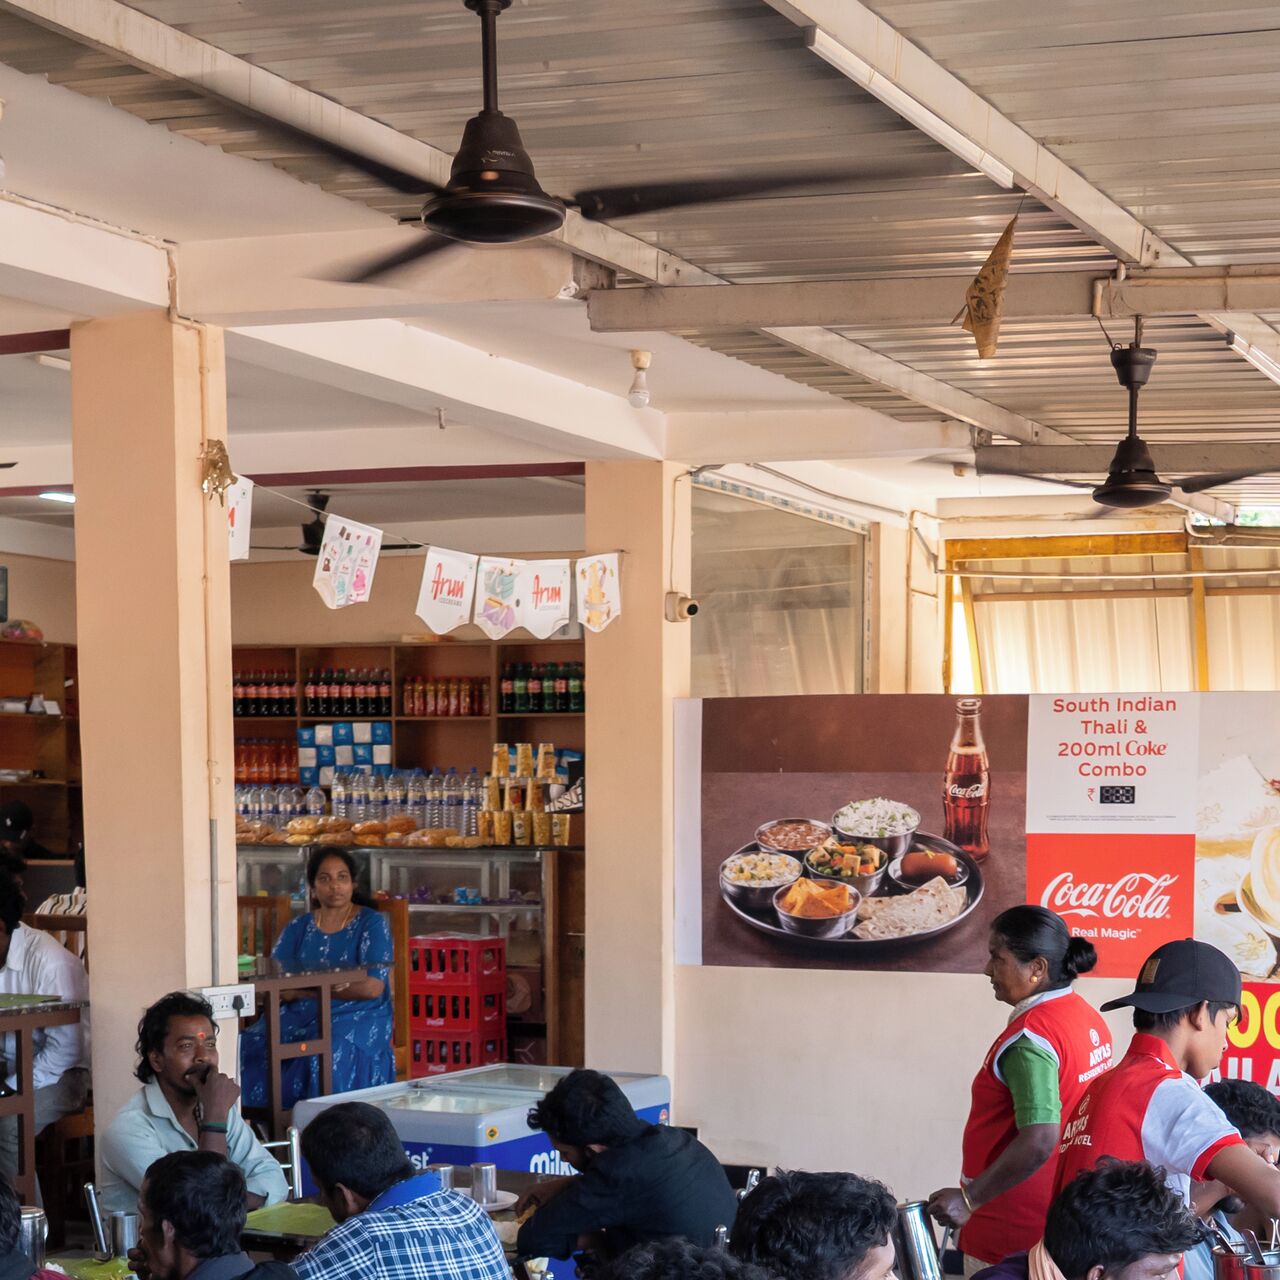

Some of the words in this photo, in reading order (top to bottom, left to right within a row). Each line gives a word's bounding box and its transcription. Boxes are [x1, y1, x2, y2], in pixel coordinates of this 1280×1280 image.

[431, 562, 465, 600] Arun
[532, 574, 561, 610] Arun
[1053, 697, 1110, 713] South
[1117, 696, 1177, 712] Indian
[1081, 719, 1128, 734] Thali
[1134, 719, 1148, 734] &
[1058, 742, 1121, 756] 200ml
[1125, 740, 1166, 756] Coke
[1078, 762, 1148, 777] Combo
[1040, 872, 1180, 919] Coca-Cola
[1071, 927, 1099, 938] Real
